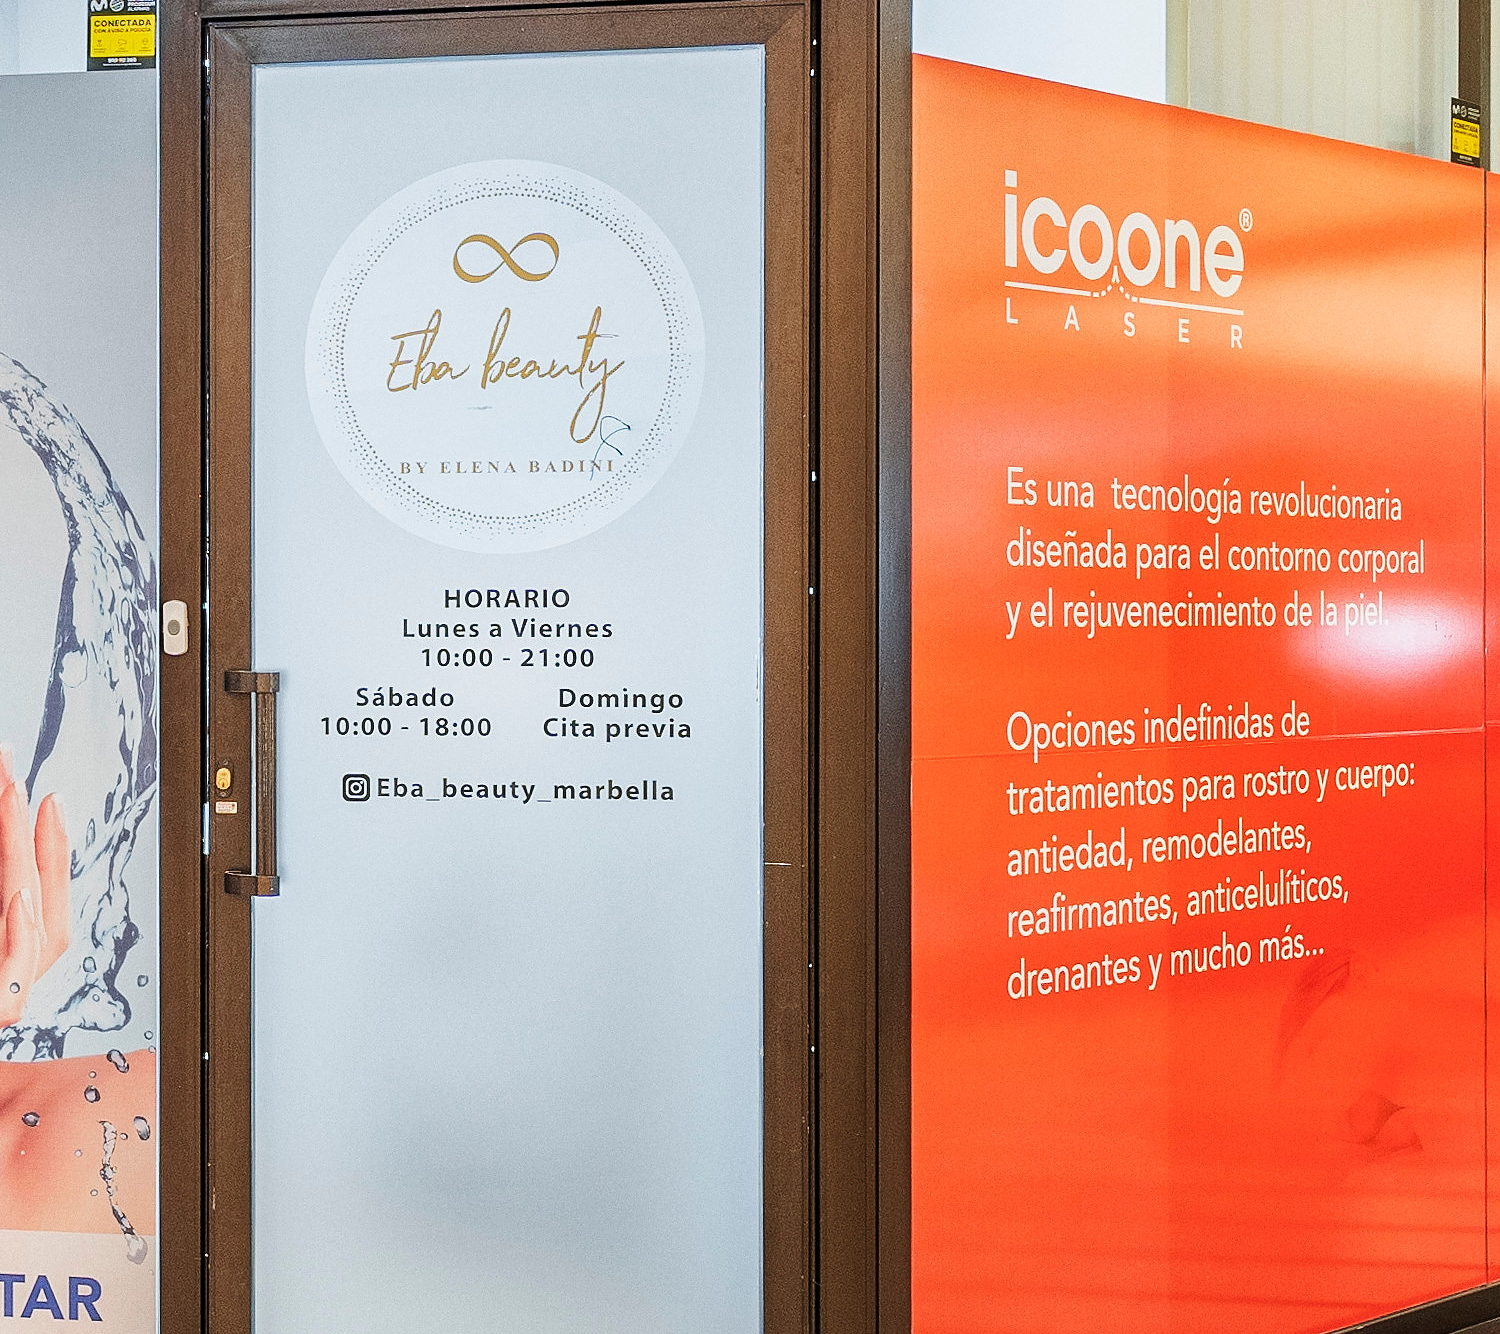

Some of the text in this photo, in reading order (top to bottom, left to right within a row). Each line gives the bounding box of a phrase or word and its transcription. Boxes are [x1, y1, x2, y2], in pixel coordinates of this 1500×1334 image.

[94, 19, 152, 28] CONECTADA
[1006, 298, 1242, 349] LASER
[387, 306, 625, 444] Eba beauty
[399, 458, 614, 475] BY ELENA BADINI
[1008, 467, 1402, 524] Es una tecnología revolucionaria
[1007, 526, 1424, 582] diseñada para el contorno corporal
[445, 589, 570, 608] HORARIO
[403, 618, 612, 638] Lunes a Viernes
[422, 649, 594, 667] 10:00 21:00
[356, 687, 454, 707] Sábado
[559, 688, 683, 713] Domingo
[321, 717, 491, 736] 10:00 18:00
[543, 717, 691, 743] Cita previa
[1007, 700, 1310, 763] Opciones indefinidas de
[378, 777, 673, 804] Eba_beauty_marbella
[1006, 763, 1414, 815] tratamientos para rostro y cuerpo:
